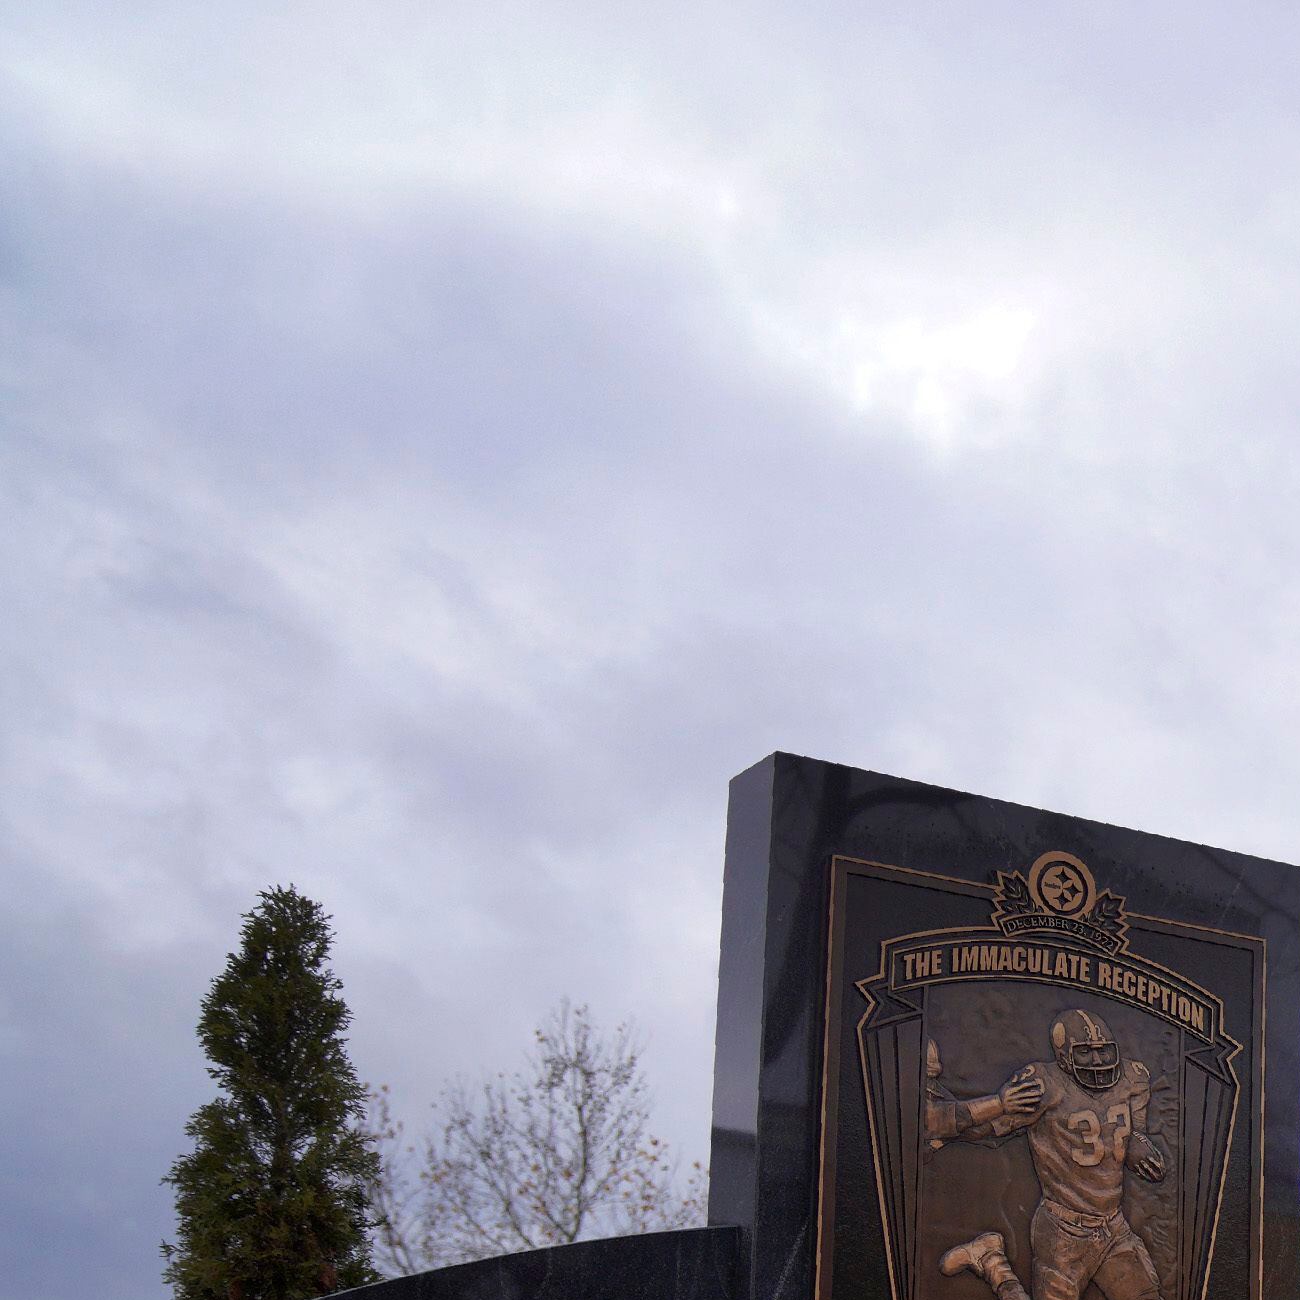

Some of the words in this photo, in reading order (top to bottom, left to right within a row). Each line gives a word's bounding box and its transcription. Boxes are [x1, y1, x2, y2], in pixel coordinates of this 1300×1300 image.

[1007, 916, 1069, 932] DECEMBER
[1072, 922, 1087, 936] 23,
[1090, 927, 1115, 950] 1972
[903, 950, 942, 980] THE
[951, 945, 1091, 983] IMMACULATE
[1097, 957, 1205, 1032] RECEPTION
